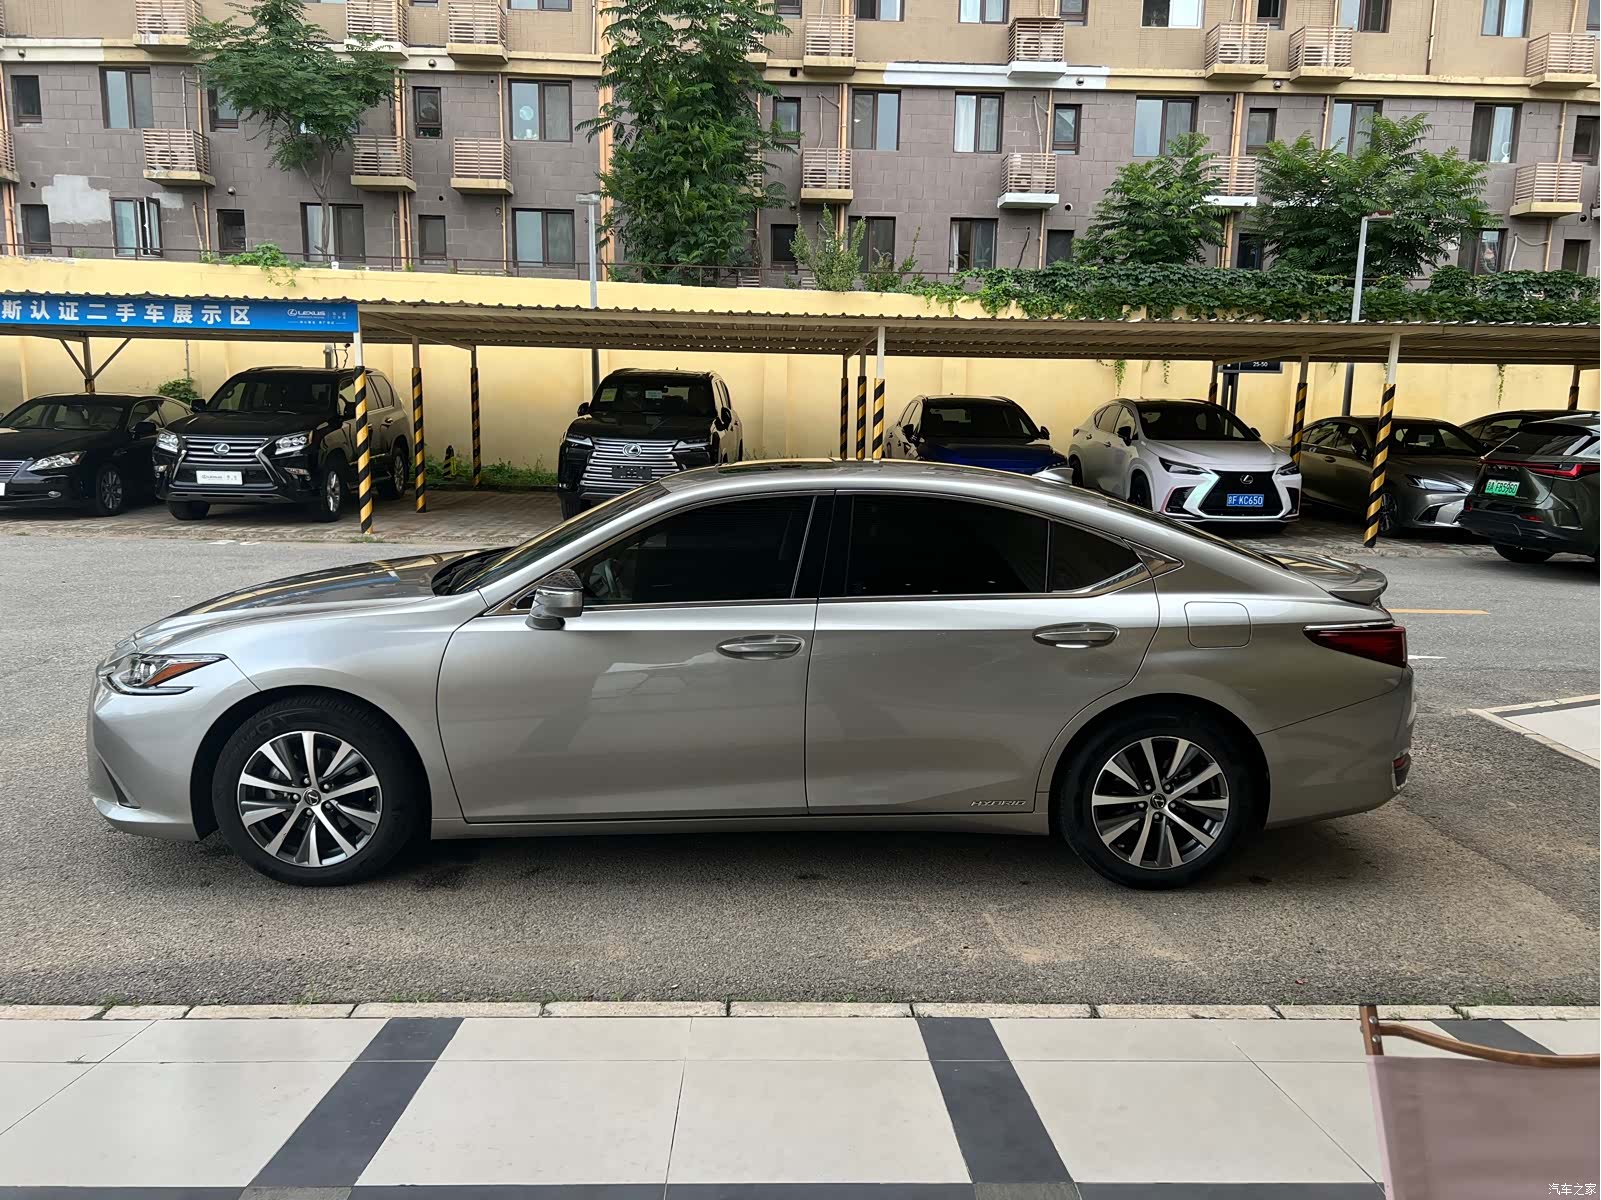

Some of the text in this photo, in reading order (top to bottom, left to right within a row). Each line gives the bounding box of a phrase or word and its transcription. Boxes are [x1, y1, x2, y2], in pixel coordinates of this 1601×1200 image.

[1, 299, 251, 325] 斯认证二手车展示区
[1238, 495, 1263, 505] KC650
